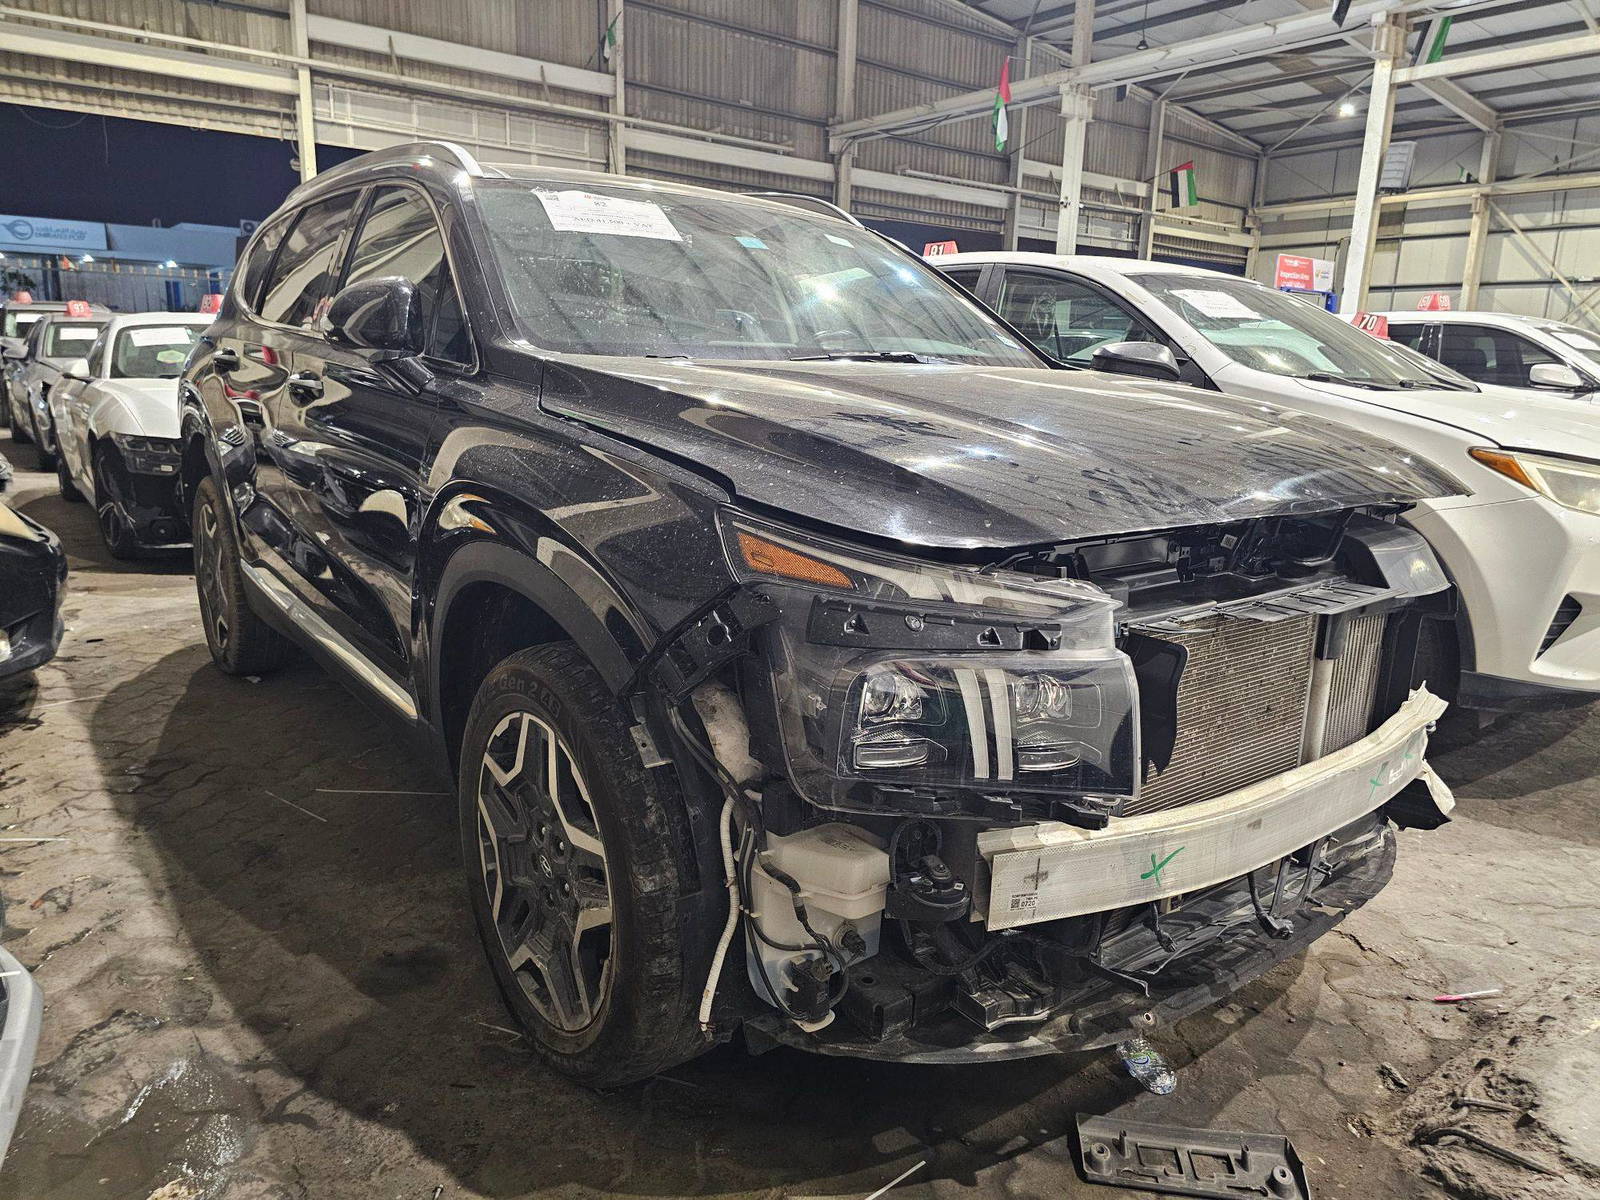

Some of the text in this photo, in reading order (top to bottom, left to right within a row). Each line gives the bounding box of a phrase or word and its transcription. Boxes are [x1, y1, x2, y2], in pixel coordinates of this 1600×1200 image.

[1359, 314, 1377, 331] 70
[500, 673, 525, 691] Gen
[527, 683, 538, 698] 2
